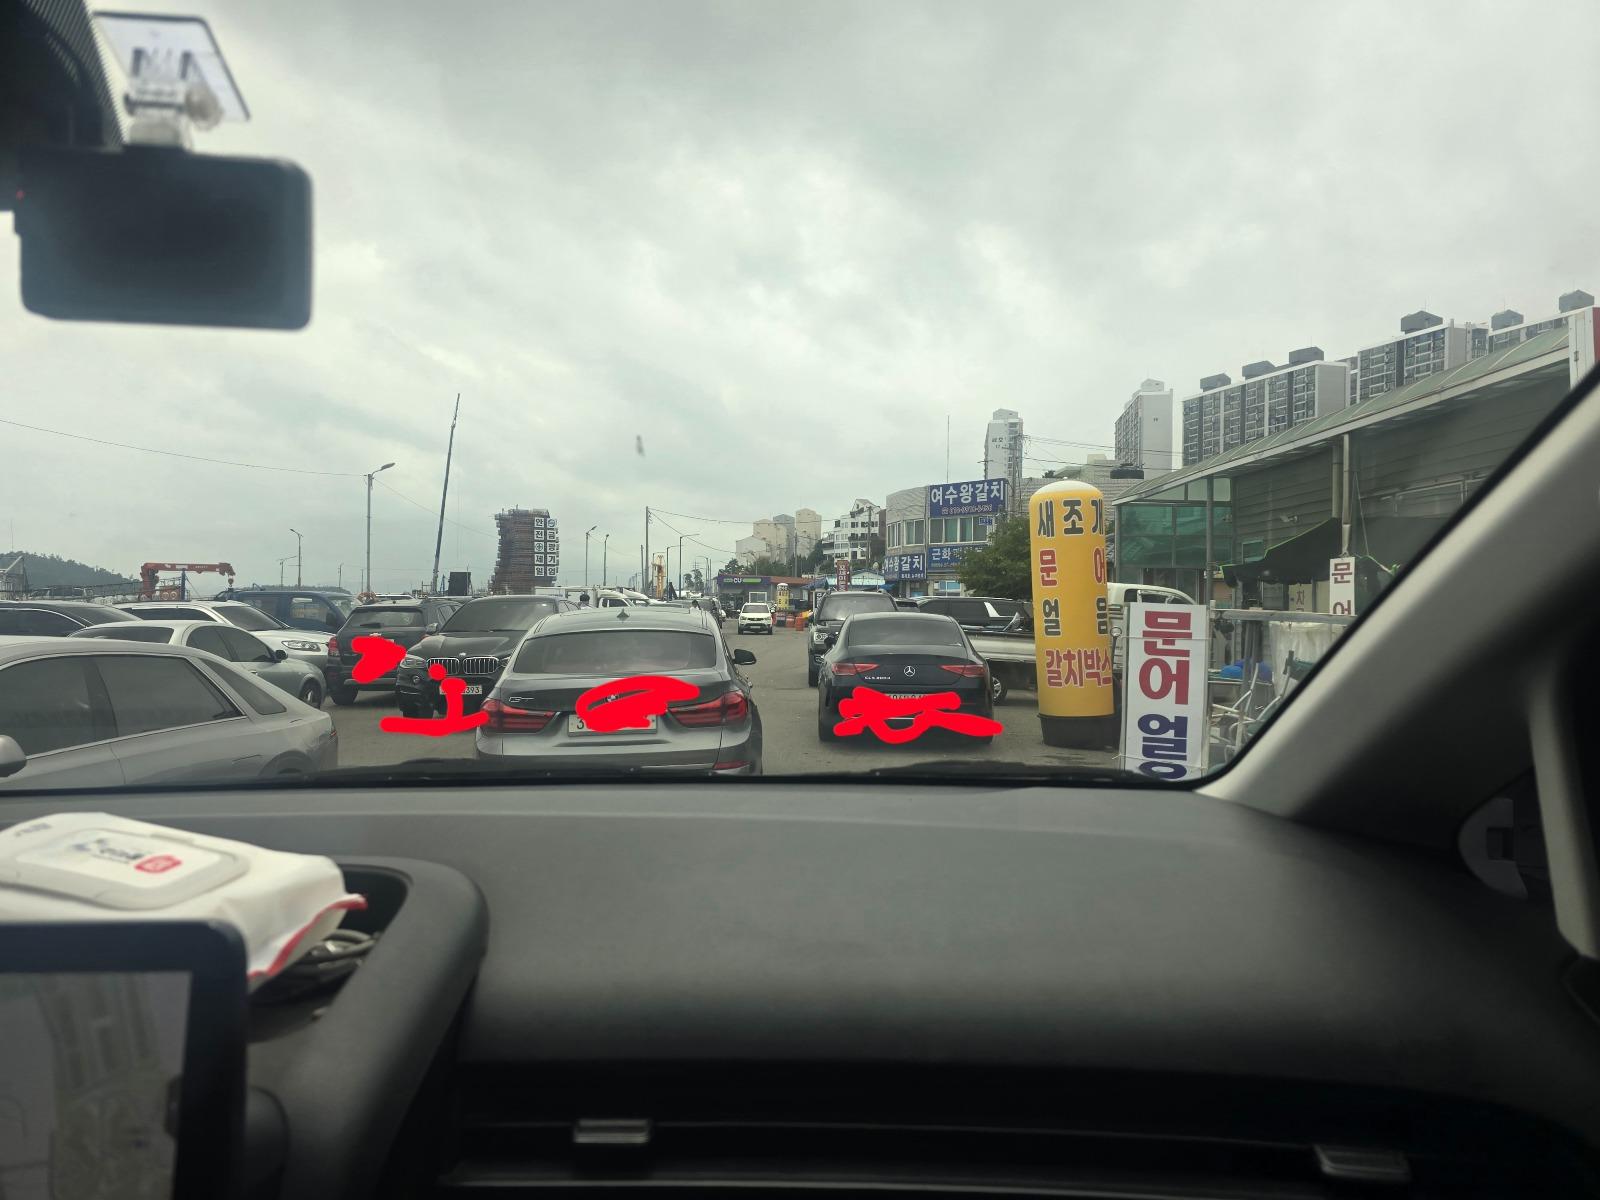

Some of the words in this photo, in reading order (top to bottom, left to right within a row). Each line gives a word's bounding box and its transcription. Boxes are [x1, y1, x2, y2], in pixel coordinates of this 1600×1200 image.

[931, 480, 1004, 505] 여수왕갈치
[1038, 498, 1104, 538] 새조개
[1138, 610, 1193, 705] 문어
